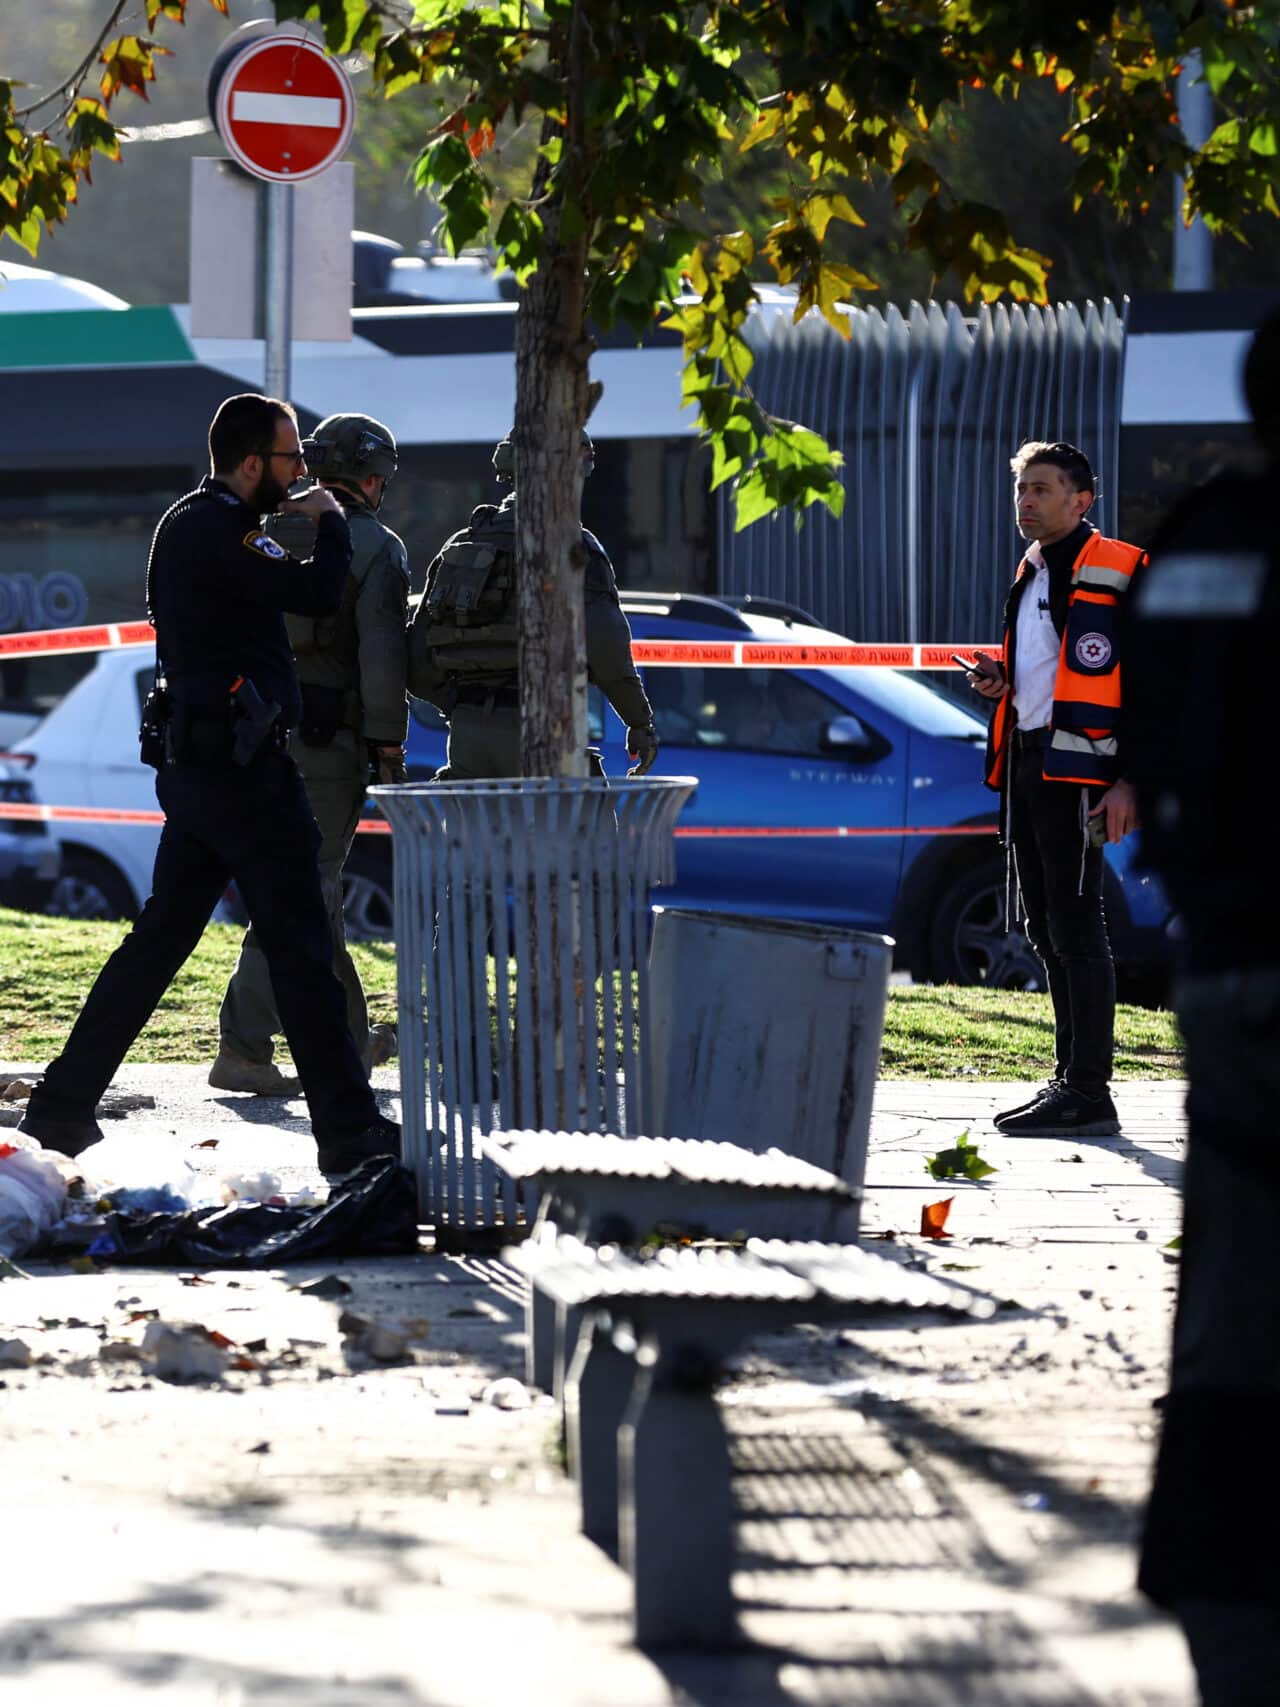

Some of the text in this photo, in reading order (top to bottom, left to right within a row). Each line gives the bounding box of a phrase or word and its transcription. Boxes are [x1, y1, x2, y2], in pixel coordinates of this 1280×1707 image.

[637, 646, 732, 659] משטרת ישראל
[748, 648, 910, 662] משטרת ישראל אין מעבר
[789, 769, 897, 786] STEPWAY
